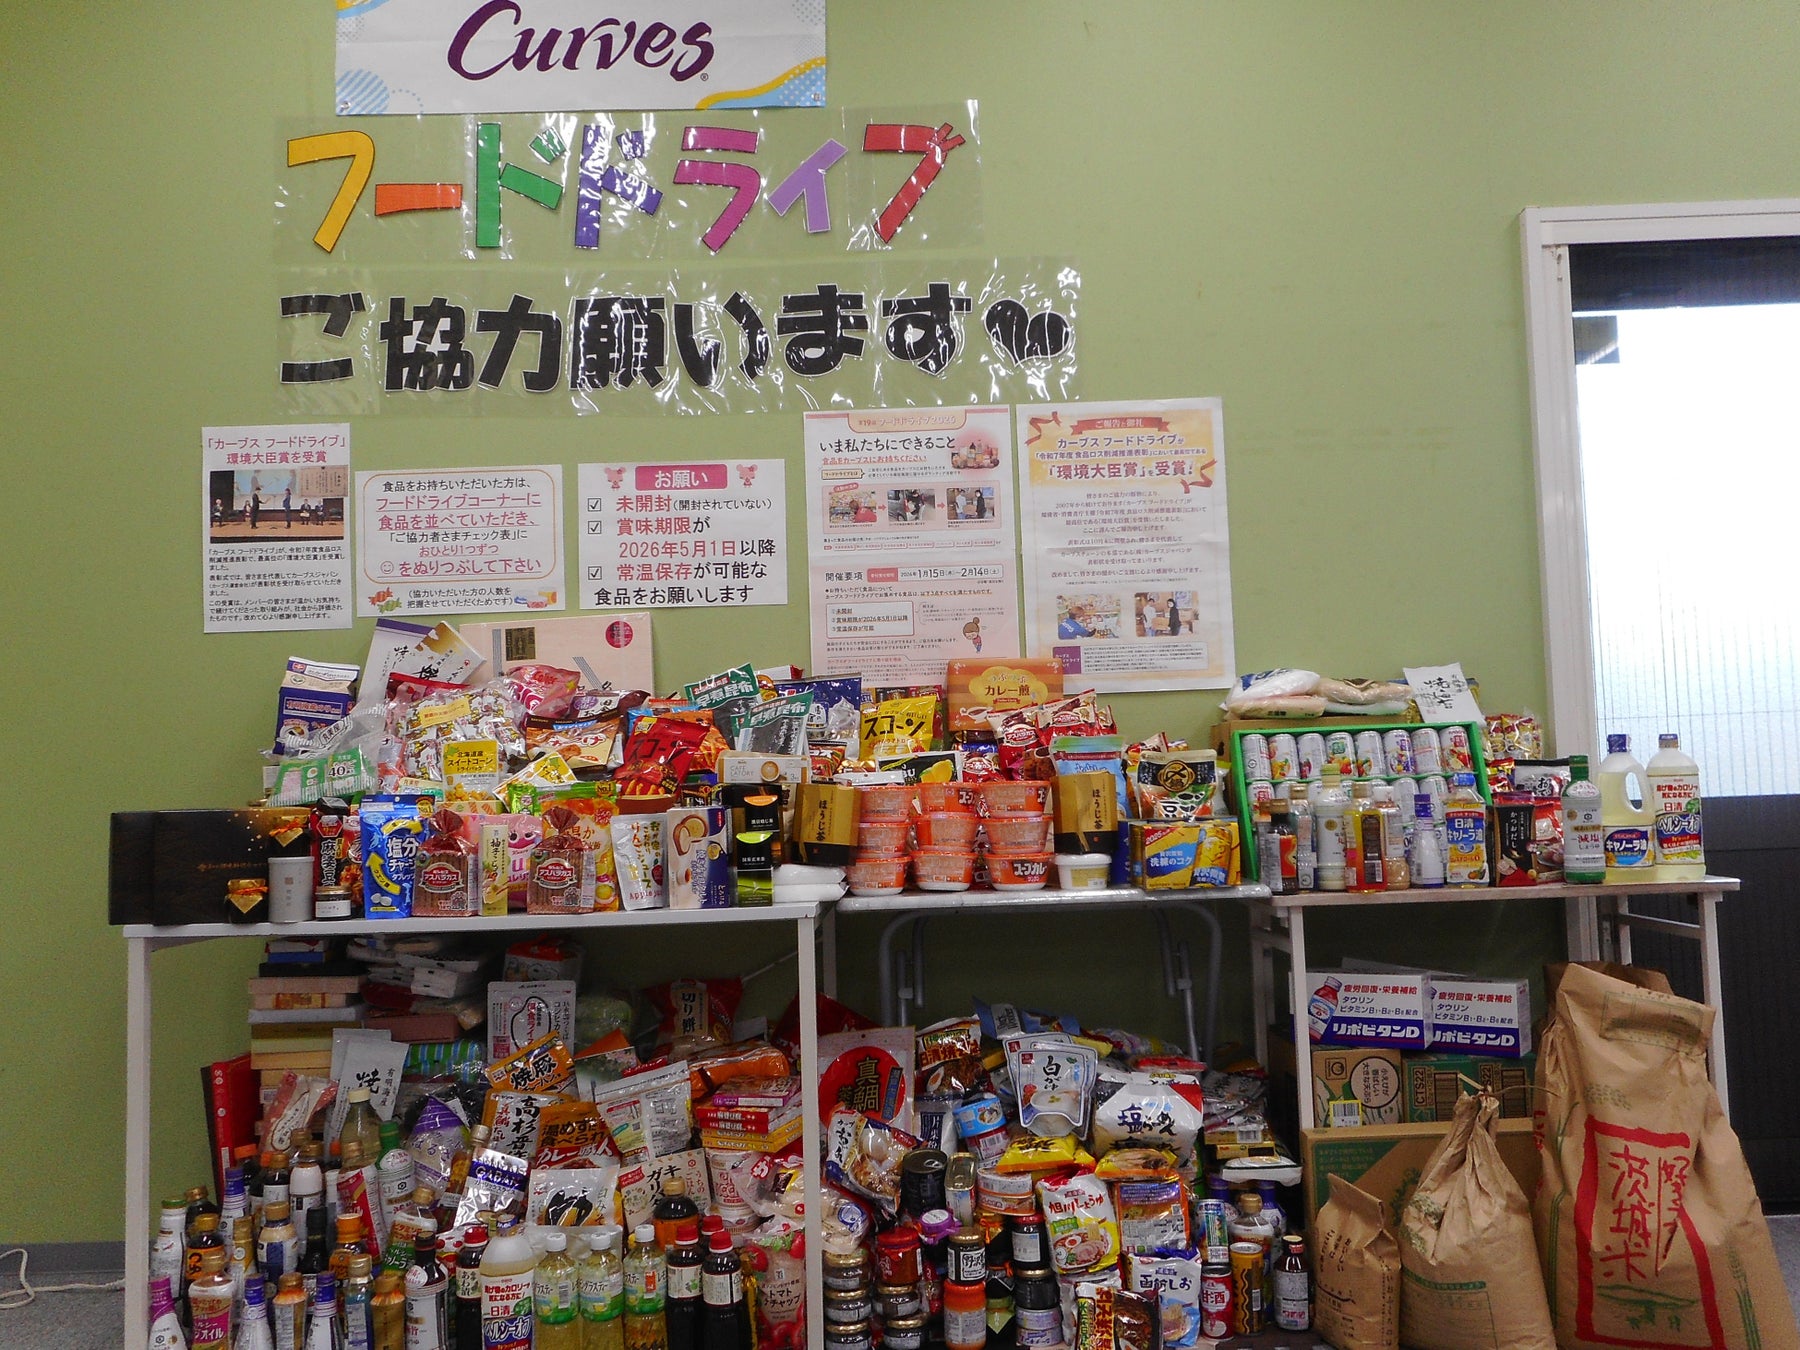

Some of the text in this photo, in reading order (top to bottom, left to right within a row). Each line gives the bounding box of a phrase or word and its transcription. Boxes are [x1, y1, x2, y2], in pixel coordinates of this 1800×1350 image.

[446, 0, 715, 81] Curves
[286, 121, 965, 254] フードドライブ
[280, 282, 973, 393] ご協力願います
[208, 435, 346, 450] 「カーブス フードドライブ」
[820, 436, 956, 453] いま私たちにできること
[1058, 437, 1099, 449] カーブス
[227, 450, 327, 465] 環境大臣賞を受賞
[383, 478, 531, 492] 食品をお持ちいただいた方は、
[654, 469, 708, 488] お願い
[376, 492, 542, 511] フードドライブコーナーに
[378, 511, 535, 530] 食品を並べていただき、
[617, 516, 711, 536] 賞味期限が
[389, 529, 528, 544] 「ご協力者さまチェック表」に
[619, 539, 776, 559] 2026年5月1日以降
[399, 558, 542, 577] をぬりつぶして下さい
[617, 561, 768, 582] 常温保存が可能な
[825, 572, 863, 582] 開催要項
[594, 585, 754, 606] 食品をお願いします
[985, 685, 1030, 696] カレー煎
[864, 716, 926, 740] スコーン
[1093, 789, 1104, 830] ほうじ茶
[1664, 802, 1683, 812] 日清
[817, 799, 827, 841] ほうじ茶
[1455, 818, 1474, 829] 日清
[1510, 811, 1518, 849] かつおだし
[387, 836, 419, 858] 塩分
[1344, 985, 1417, 995] 疲労回復・栄養補給
[1438, 991, 1514, 1004] 疲労回復・栄養補給
[1342, 996, 1374, 1004] タウリン
[1437, 1003, 1469, 1012] タウリン
[1332, 1022, 1420, 1038] リポビタンD
[1042, 1055, 1062, 1091] 白がゆ
[856, 1057, 879, 1111] 真鯛
[1415, 1070, 1425, 1104] CTS22
[1140, 1274, 1192, 1293] 函館しお
[491, 1305, 510, 1316] 日清
